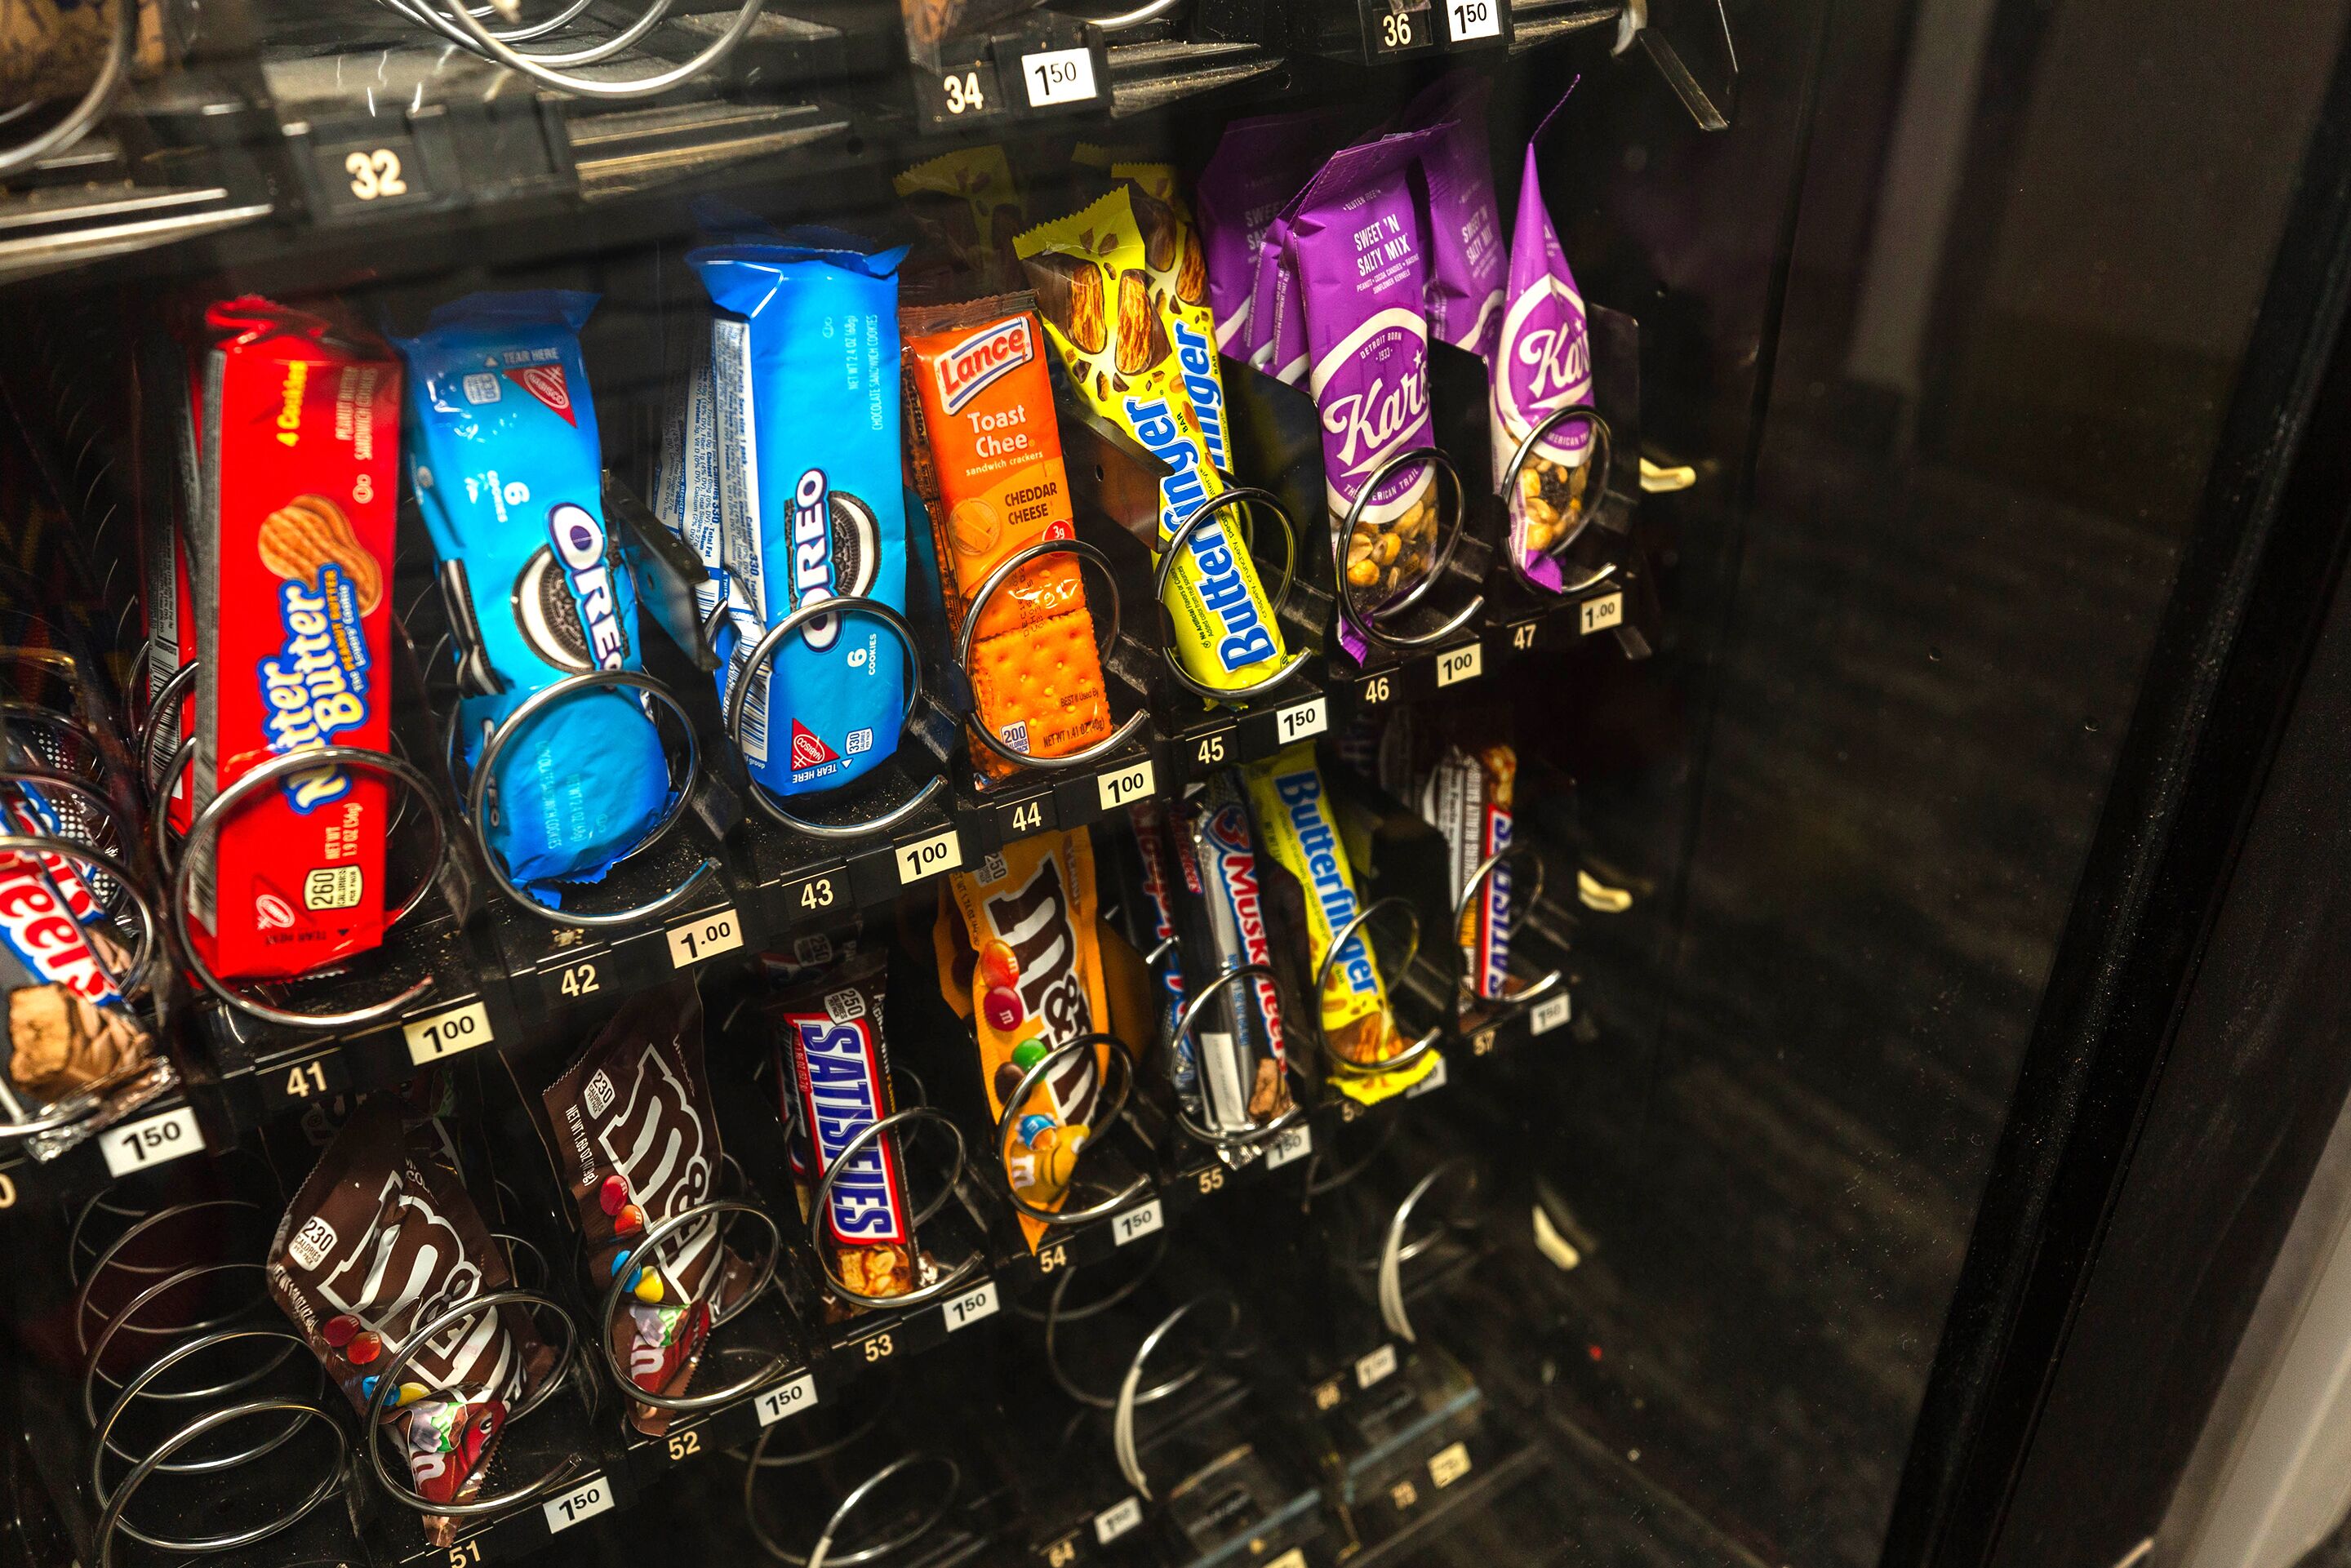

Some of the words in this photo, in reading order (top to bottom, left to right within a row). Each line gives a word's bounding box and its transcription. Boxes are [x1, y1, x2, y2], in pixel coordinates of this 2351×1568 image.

[1382, 12, 1411, 47] 36
[943, 71, 984, 113] 34
[345, 148, 407, 201] 32
[1353, 221, 1384, 251] SWEET
[1357, 247, 1384, 278] SALTY
[1384, 233, 1411, 261] MIX
[503, 349, 531, 365] TEAR
[531, 347, 561, 362] HERE
[1360, 334, 1385, 360] DETROIT
[940, 328, 1025, 396] Lance
[869, 389, 882, 430] CHOCOLATE
[967, 404, 1026, 434] Toast
[1177, 411, 1189, 433] BAR
[276, 432, 300, 447] 4
[976, 433, 1029, 459] Chee
[966, 459, 1007, 477] sandwich
[1009, 450, 1044, 466] crackers
[1398, 468, 1420, 488] TRAIL
[503, 482, 531, 506] 6
[1004, 481, 1058, 507] CHEDDAR
[696, 510, 704, 532] Sugars
[1008, 503, 1049, 525] CHEESE
[700, 526, 709, 550] Sodium
[707, 527, 715, 544] Total
[1054, 525, 1065, 540] 3g
[1178, 566, 1190, 585] sources
[324, 570, 342, 621] BUTTER
[1180, 590, 1191, 608] Flavors
[1189, 609, 1202, 630] Artificial
[1198, 607, 1206, 620] color
[1585, 602, 1615, 629] 1.00
[1199, 632, 1206, 640] No
[1203, 620, 1213, 637] Added
[1513, 624, 1537, 651] 47
[285, 585, 367, 733] Butter
[331, 620, 356, 672] PEANUT
[847, 647, 868, 668] 6
[869, 633, 877, 676] COOKIES
[1365, 677, 1389, 704] 46
[849, 732, 860, 752] 330
[1003, 725, 1026, 744] 200
[1043, 734, 1056, 748] NET
[794, 736, 824, 762] NABISCO
[1198, 735, 1225, 765] 45
[792, 770, 815, 784] HERE
[816, 764, 838, 777] TEAR
[1011, 801, 1042, 832] 44
[1213, 808, 1251, 849] 3
[343, 828, 359, 842] OZ
[311, 872, 335, 906] 260
[801, 878, 834, 910] 43
[680, 921, 731, 959] 1.00
[560, 963, 600, 997] 42
[839, 988, 865, 1018] 250
[287, 1061, 327, 1098] 41
[592, 1071, 614, 1102] 230
[565, 1105, 578, 1123] NET
[571, 1121, 581, 1134] WT
[574, 1132, 587, 1151] 1.69
[1198, 1167, 1224, 1195] 55
[300, 1219, 335, 1252] 230
[294, 1236, 322, 1264] CALORIES
[1039, 1245, 1068, 1273] 54
[864, 1333, 894, 1362] 53
[668, 1431, 701, 1463] 52
[448, 1539, 482, 1568] 51
